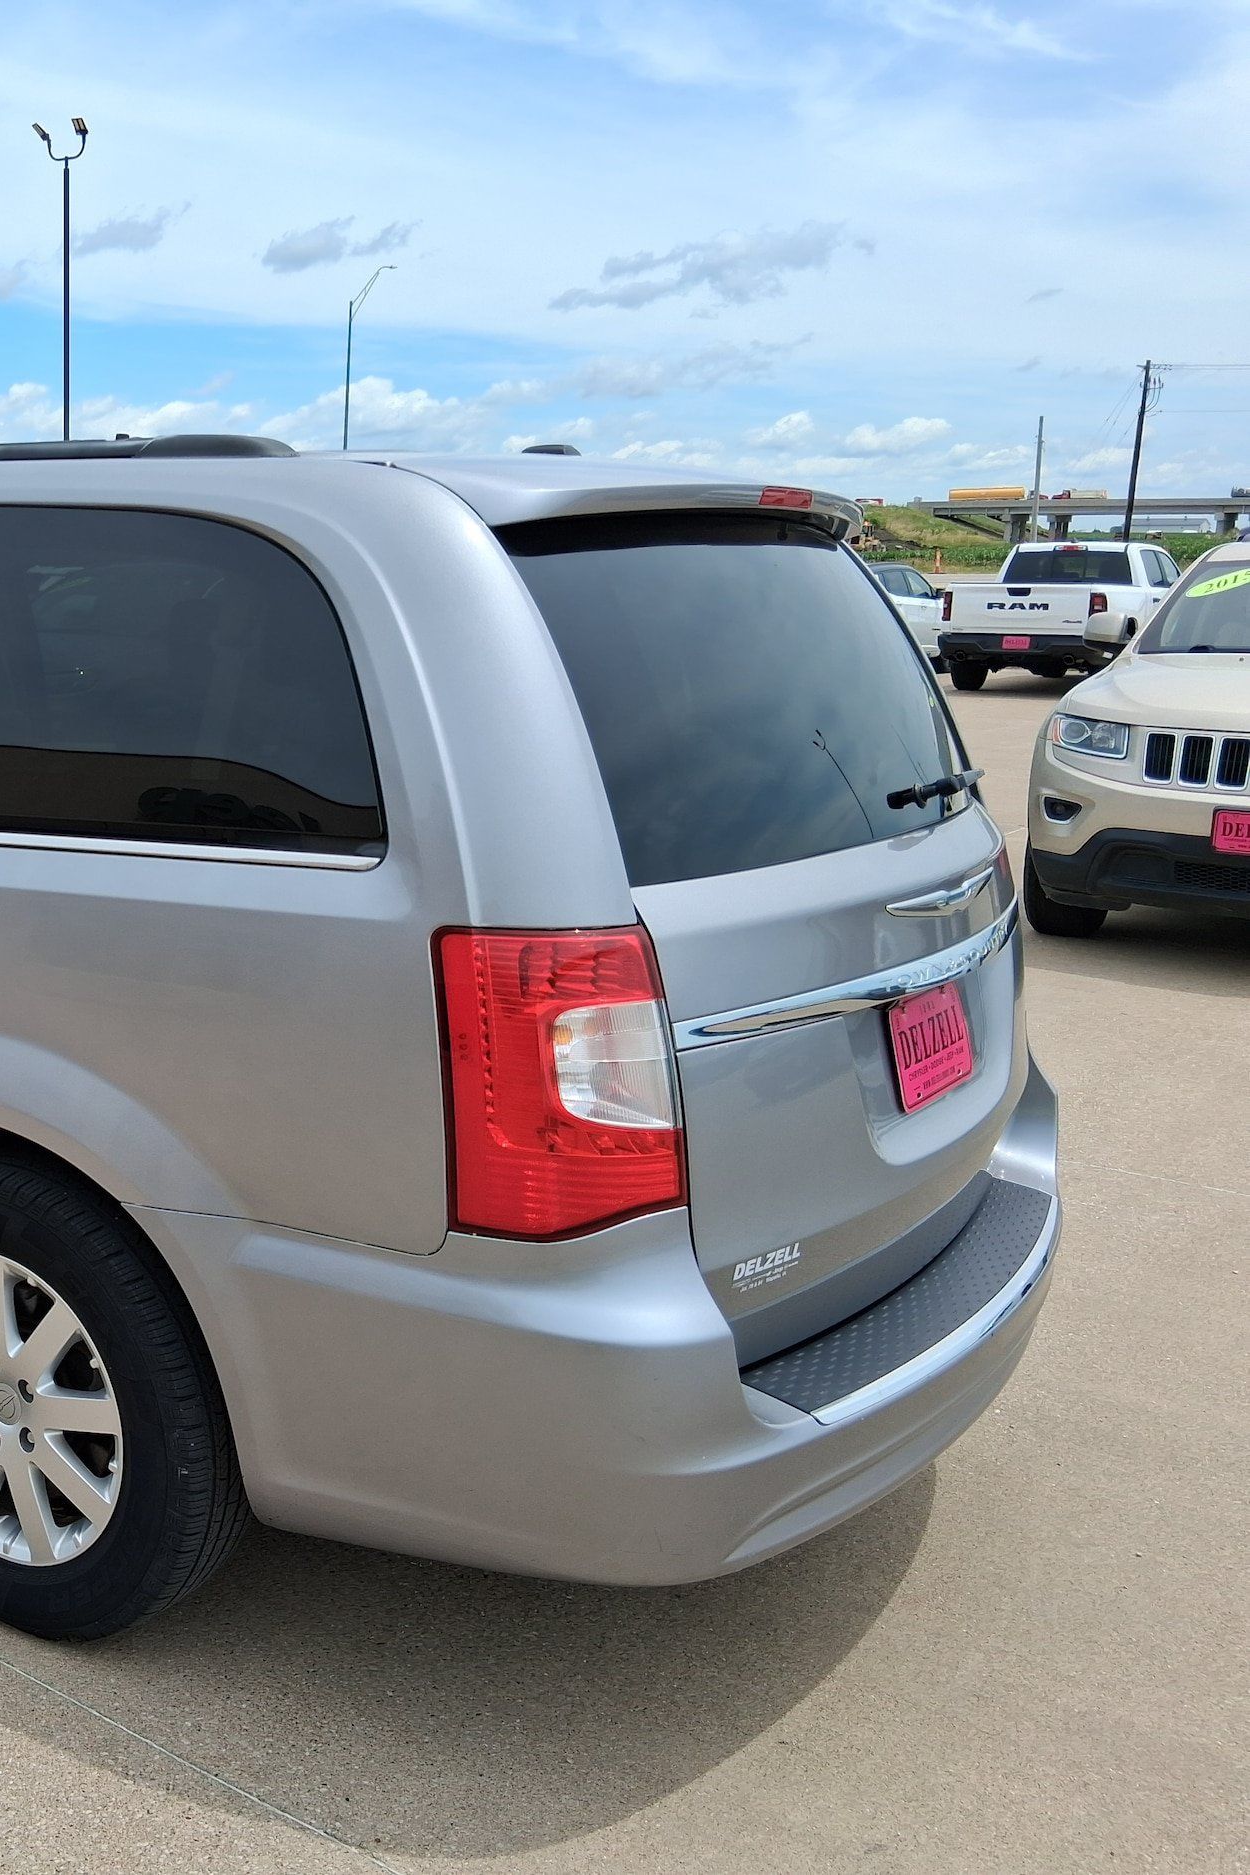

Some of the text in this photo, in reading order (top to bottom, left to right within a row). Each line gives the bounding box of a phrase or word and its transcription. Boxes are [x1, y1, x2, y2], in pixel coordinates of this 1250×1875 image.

[987, 602, 1049, 611] RAM
[898, 1005, 964, 1071] DELZELL
[733, 1242, 801, 1281] DELZELL
